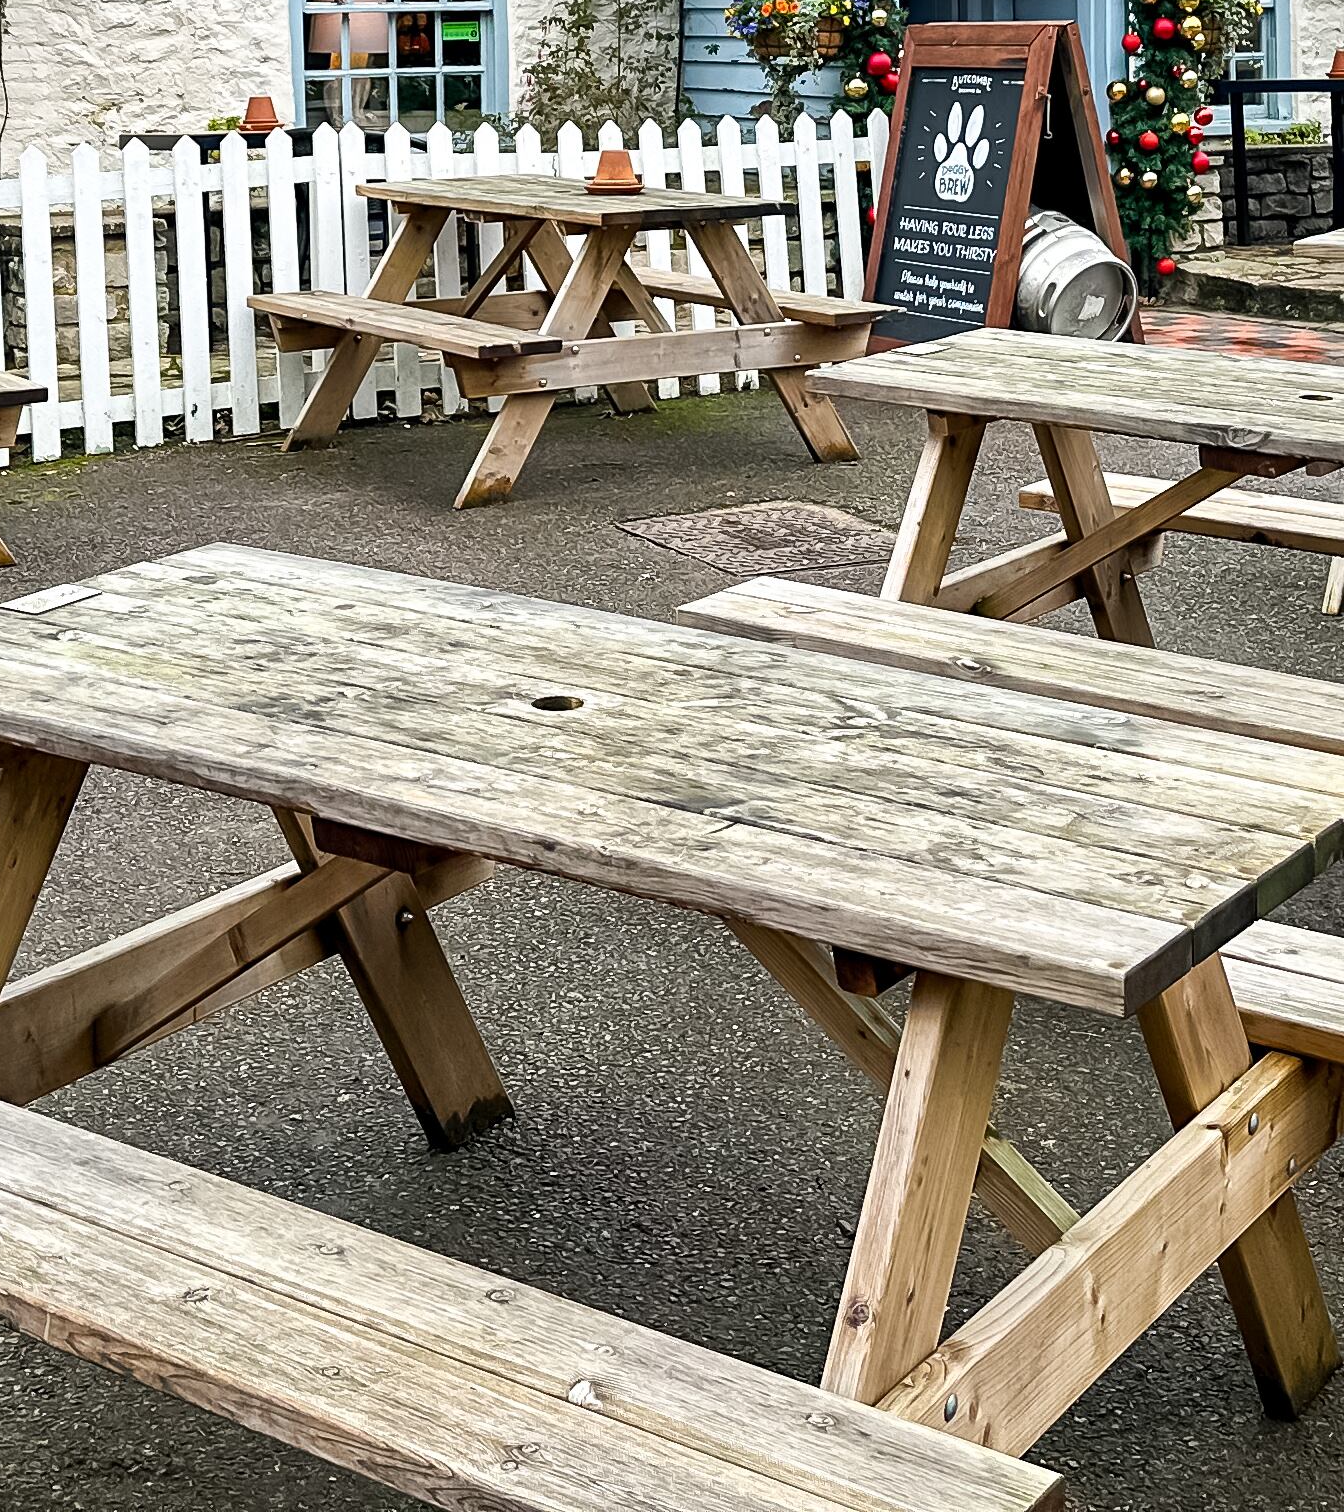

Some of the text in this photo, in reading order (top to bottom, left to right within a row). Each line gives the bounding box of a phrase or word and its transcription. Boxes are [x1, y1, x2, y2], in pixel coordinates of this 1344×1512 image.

[939, 175, 971, 196] BREW
[899, 216, 995, 241] HAVING FOUR LEGS
[893, 236, 998, 264] MAKES YOU THIRSTY
